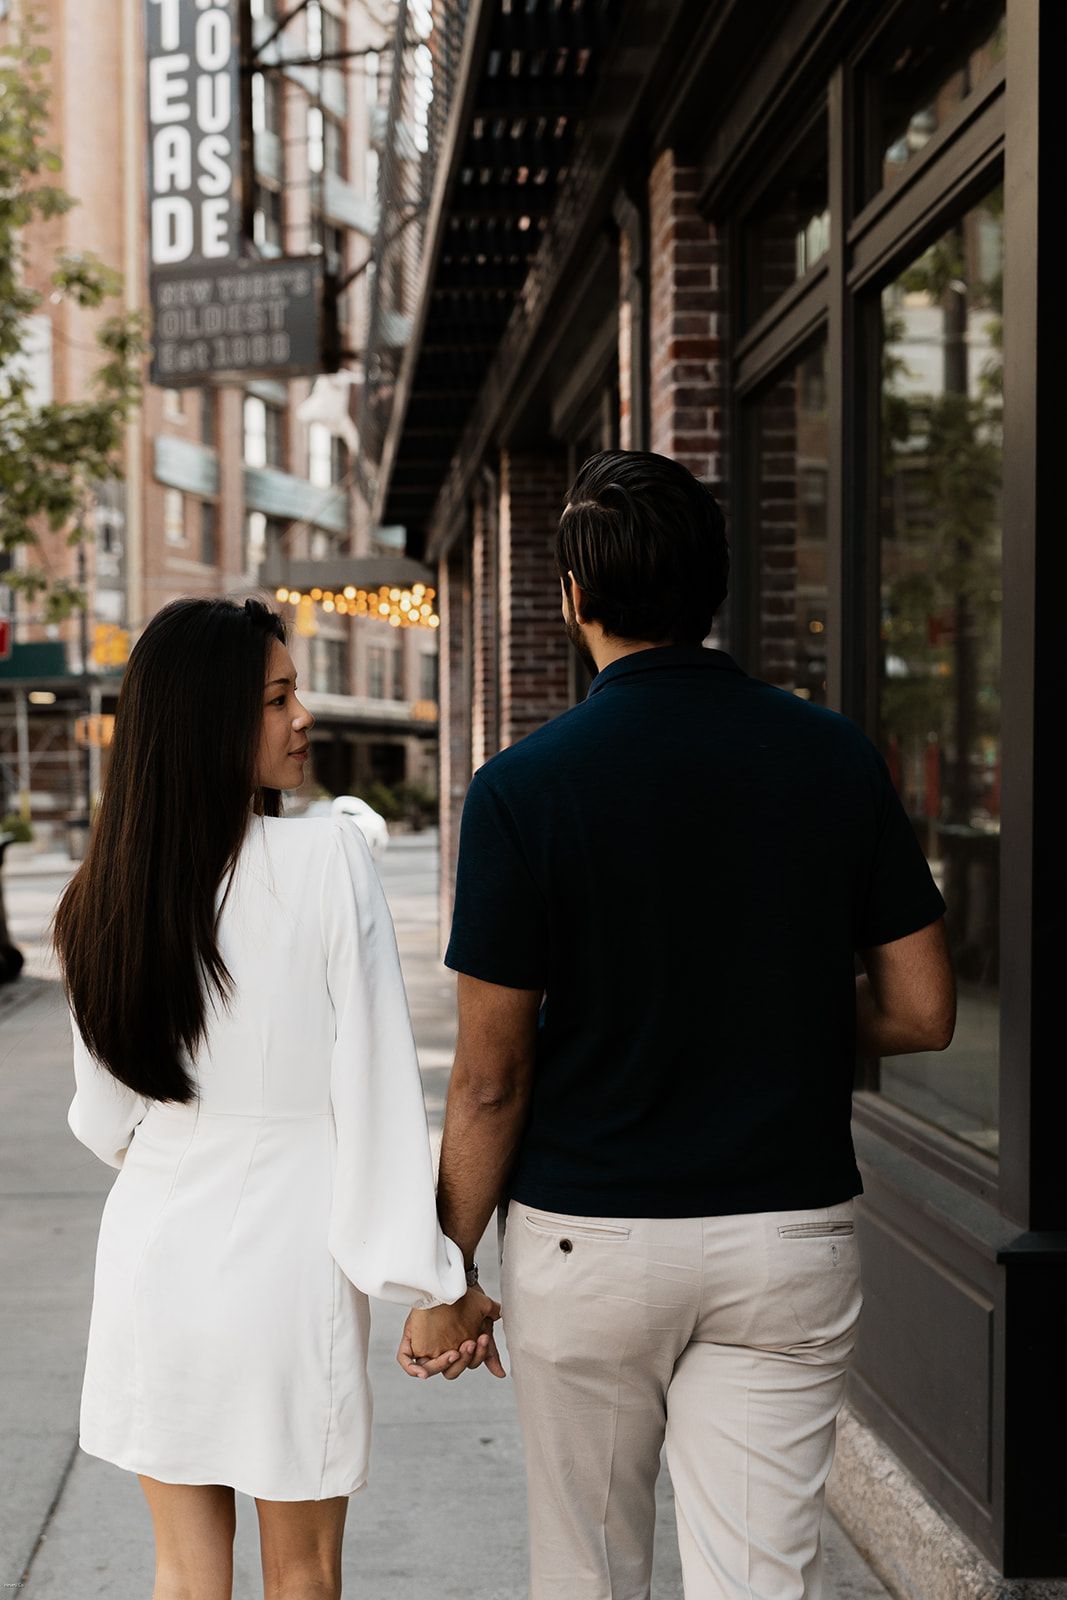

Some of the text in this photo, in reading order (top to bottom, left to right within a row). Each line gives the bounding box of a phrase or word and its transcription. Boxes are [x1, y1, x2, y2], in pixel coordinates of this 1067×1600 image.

[150, 0, 194, 264] TEAD
[195, 0, 232, 259] OUSE
[158, 298, 288, 339] OLDEST
